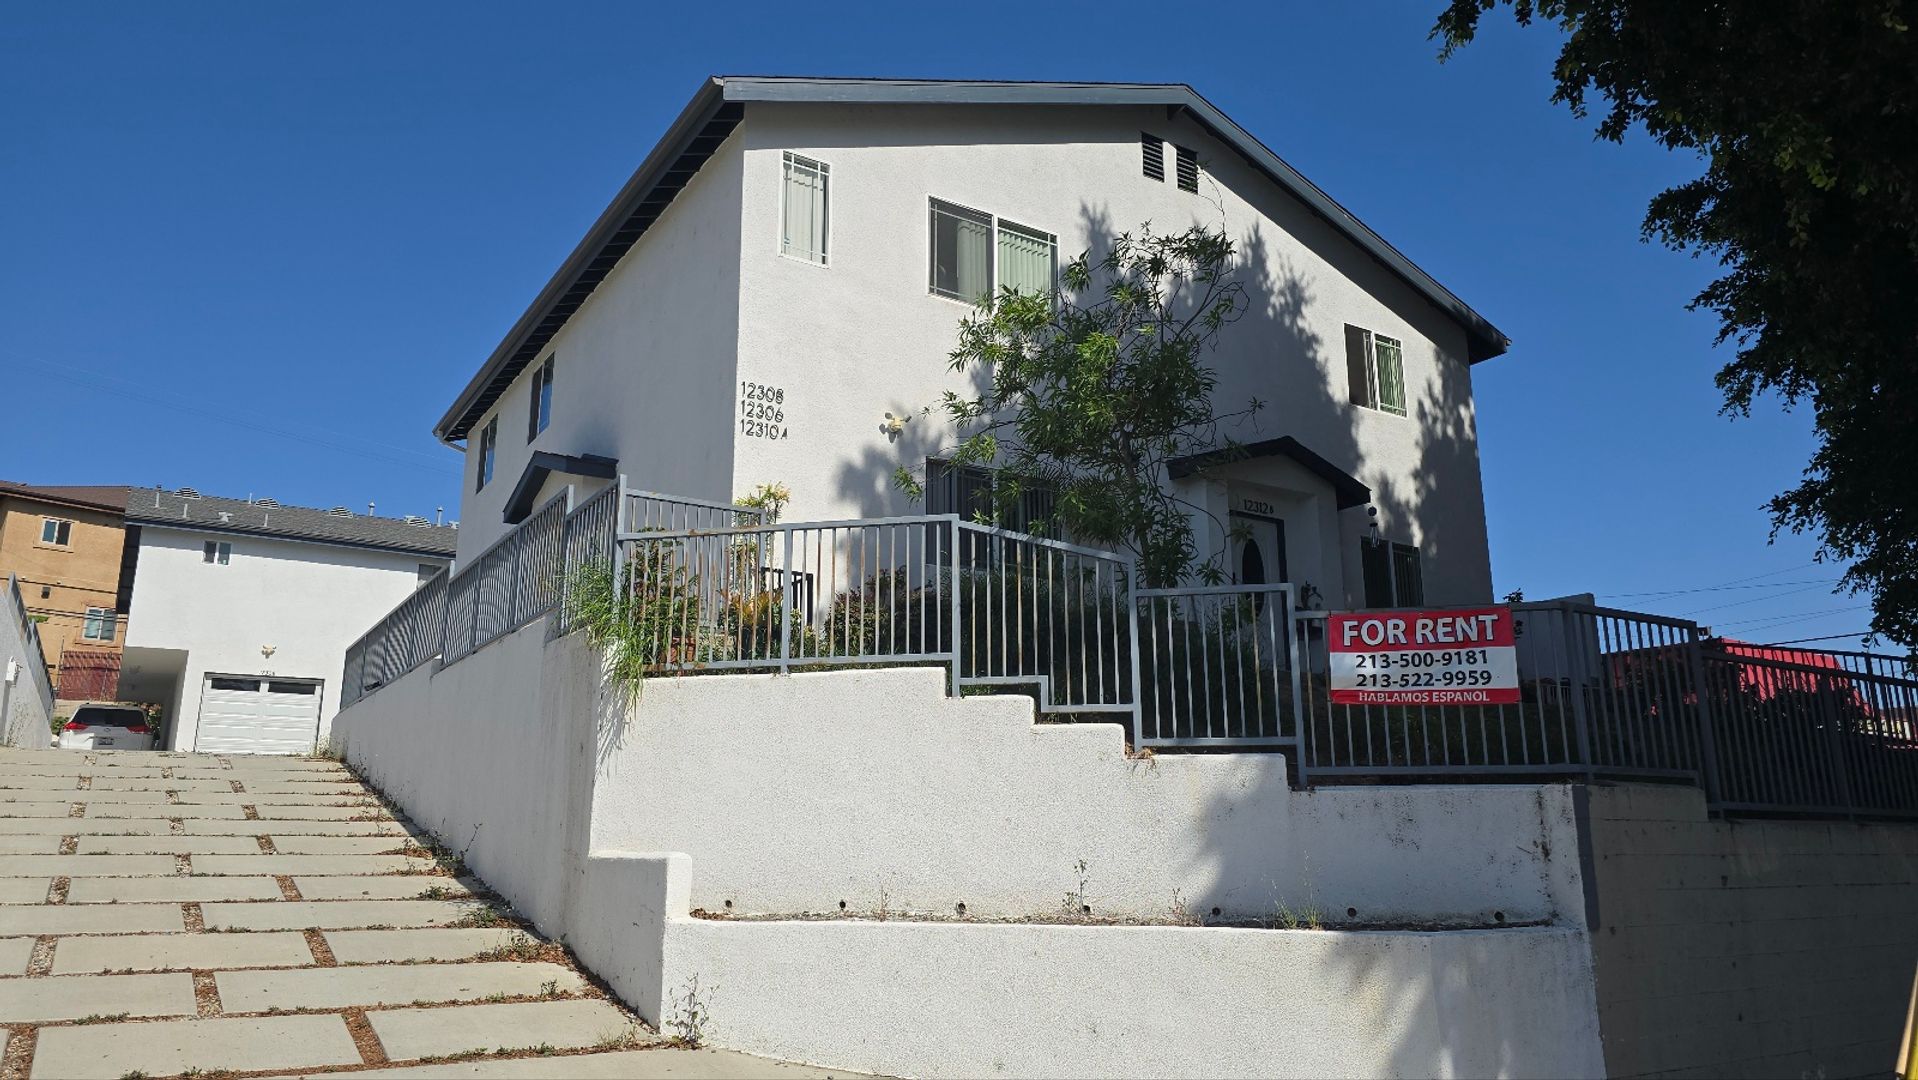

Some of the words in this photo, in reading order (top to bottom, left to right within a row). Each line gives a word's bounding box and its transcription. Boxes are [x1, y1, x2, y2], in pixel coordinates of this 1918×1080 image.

[741, 381, 784, 405] 12308
[741, 400, 784, 423] 12306
[1343, 618, 1408, 647] FOR
[1415, 614, 1499, 645] RENT
[1355, 650, 1488, 669] 213-500-9181
[1355, 670, 1492, 688] 213-522-9959
[1359, 691, 1429, 703] HABLAMOS
